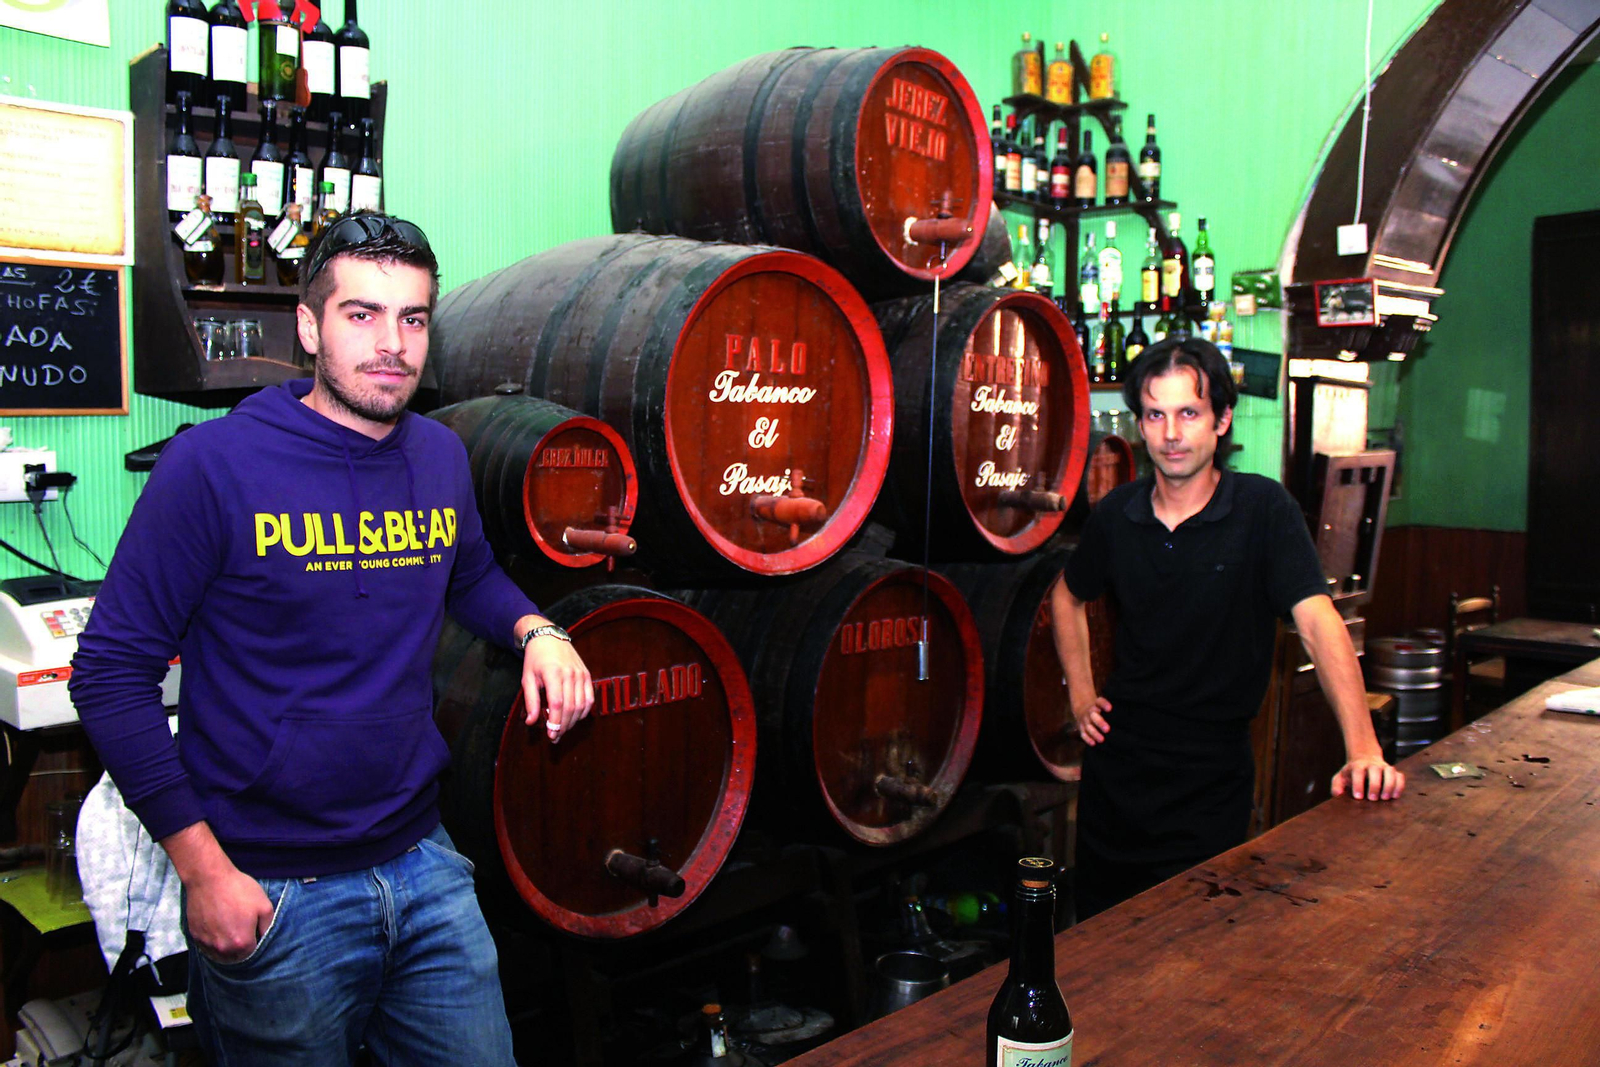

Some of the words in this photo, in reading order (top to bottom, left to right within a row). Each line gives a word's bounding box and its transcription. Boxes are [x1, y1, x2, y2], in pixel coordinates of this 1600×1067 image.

[885, 78, 949, 126] JEREZ
[885, 112, 948, 162] VIEJO
[0, 266, 27, 279] AS
[0, 325, 73, 352] ADA
[724, 333, 807, 376] PALO
[709, 369, 817, 404] Tabanco
[970, 385, 1039, 416] Tabanco
[748, 416, 780, 449] El
[994, 424, 1018, 451] El
[719, 462, 806, 498] Pasaj
[305, 560, 323, 572] AN
[325, 561, 353, 571] EVER
[358, 558, 391, 570] OUNG
[391, 554, 442, 567] COMMUITY
[590, 662, 702, 717] TILLADO
